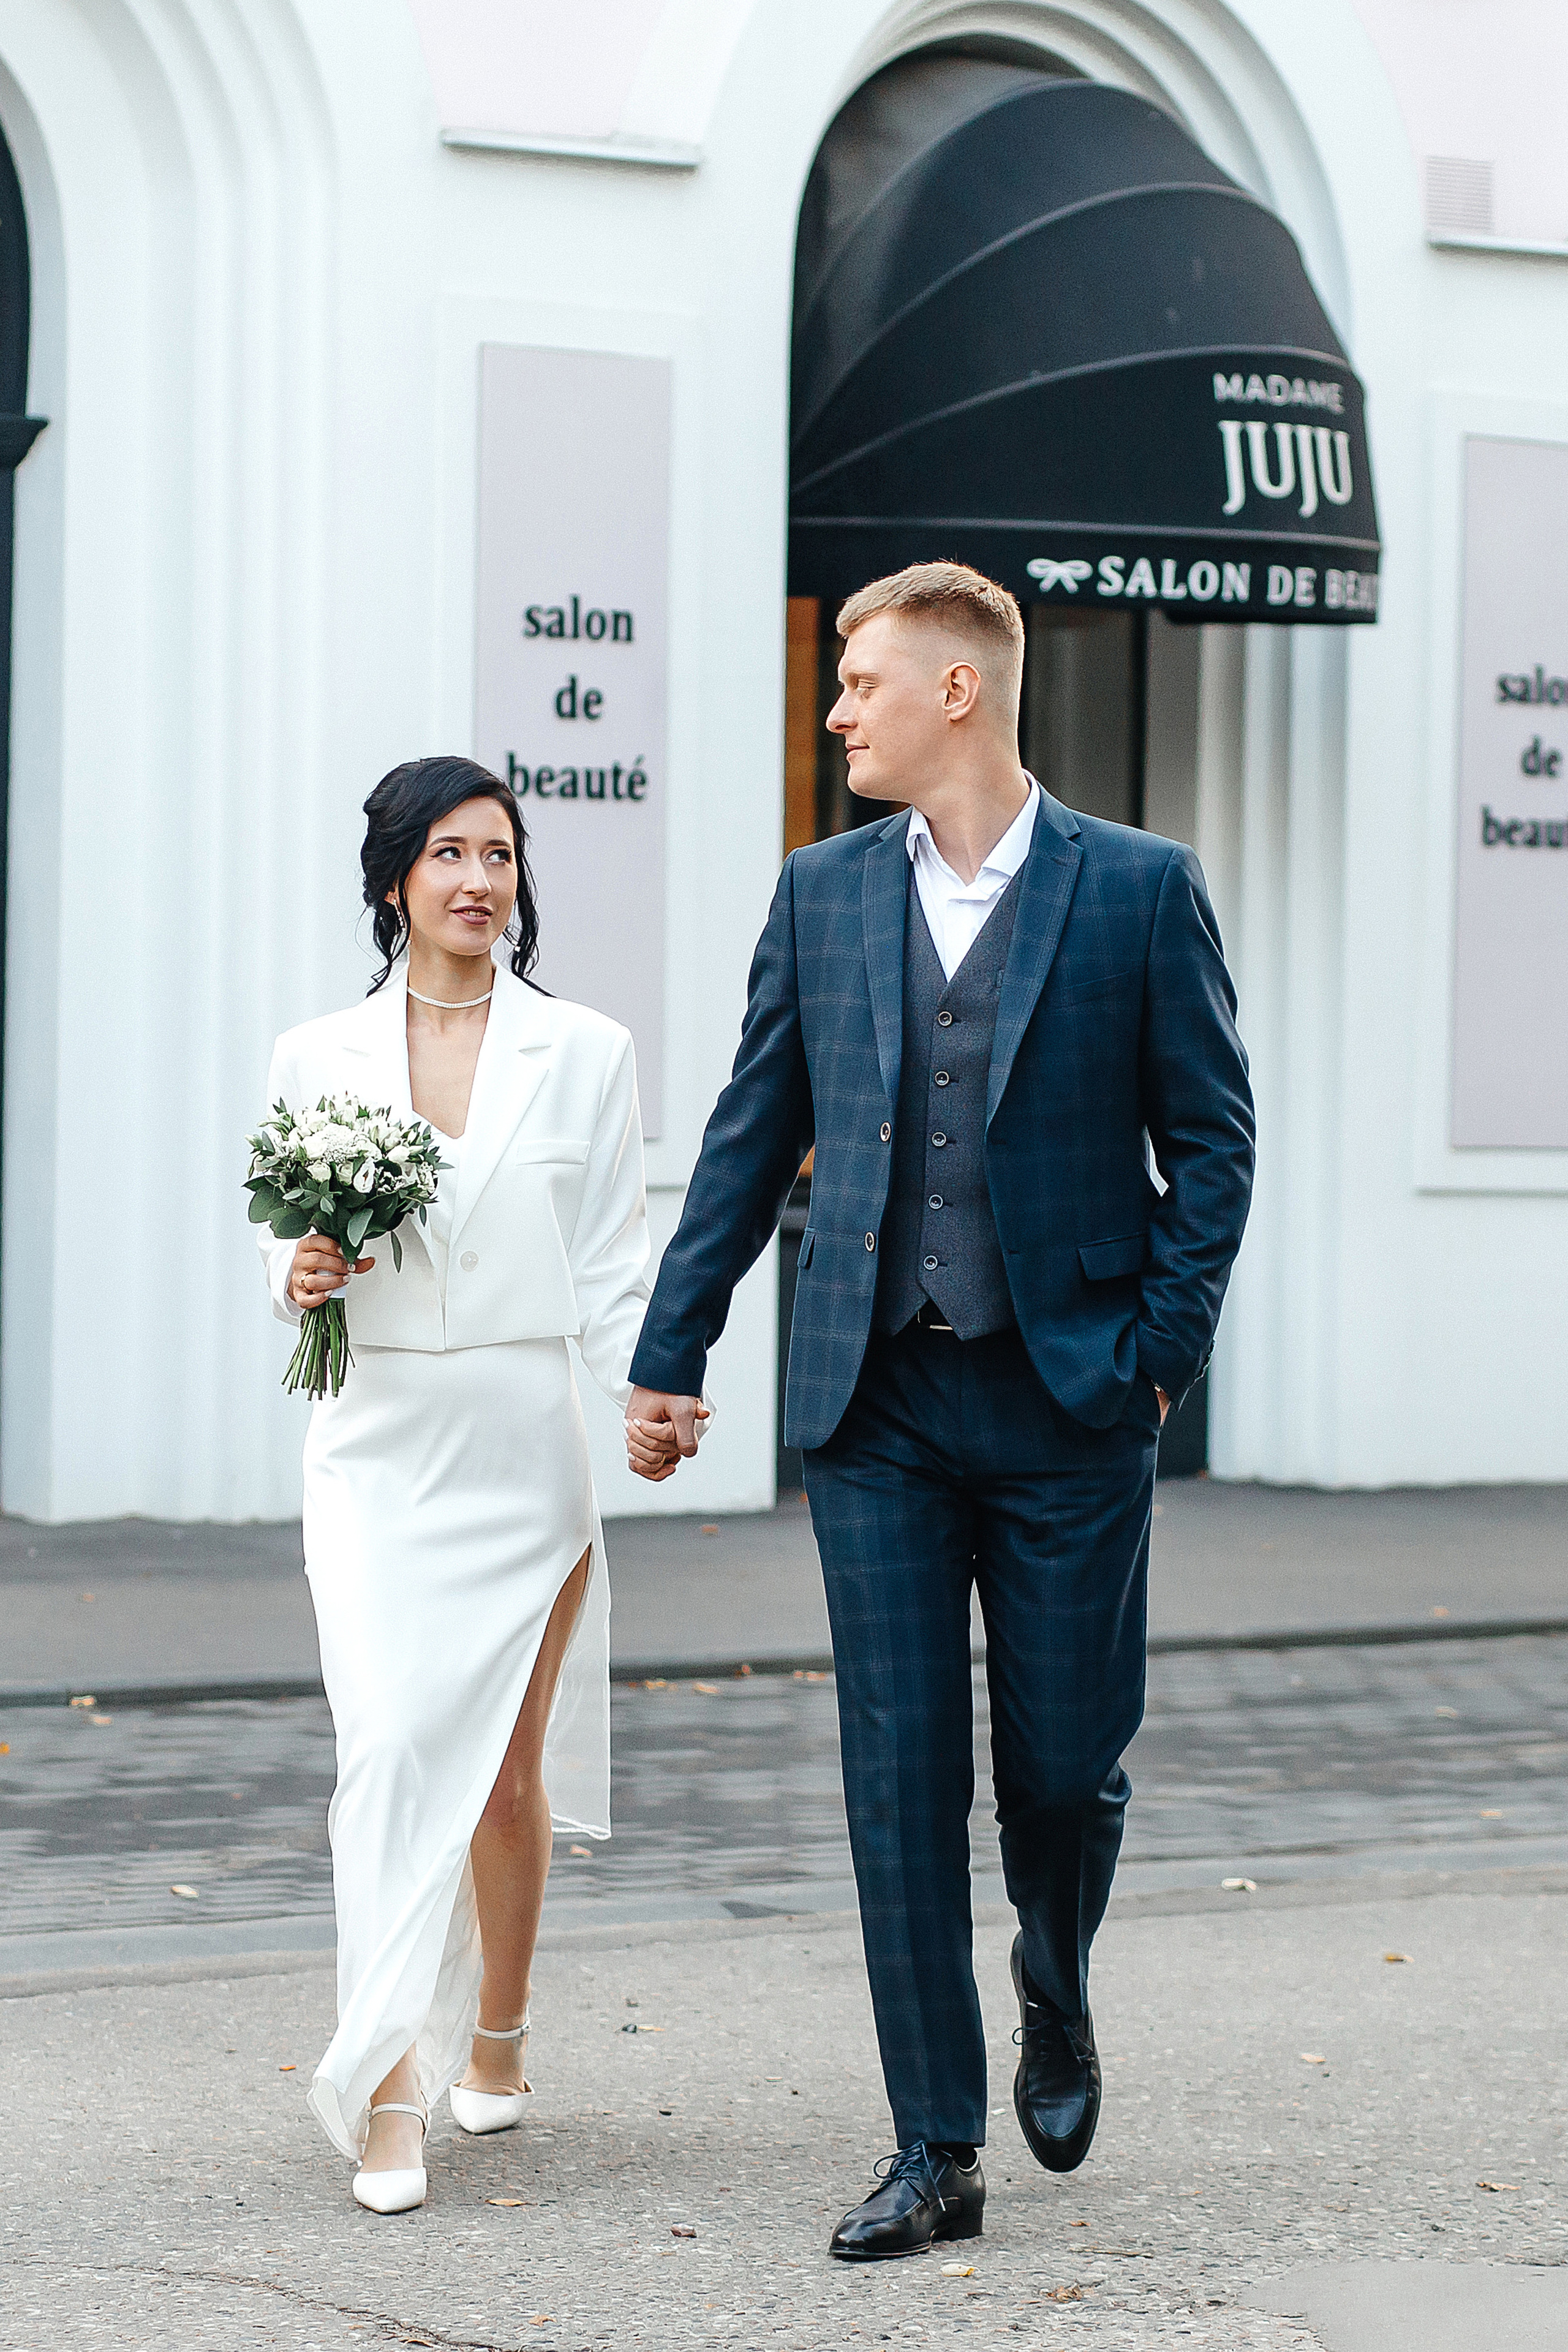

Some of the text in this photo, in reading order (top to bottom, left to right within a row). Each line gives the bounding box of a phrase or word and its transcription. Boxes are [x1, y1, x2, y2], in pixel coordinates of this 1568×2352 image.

[1213, 372, 1344, 414] MADAME
[1218, 420, 1353, 516] JUJU
[1097, 556, 1250, 601] SALON
[1267, 565, 1317, 606] DE
[523, 594, 635, 643] salon
[555, 674, 603, 720] de
[1496, 664, 1568, 705] salo
[507, 751, 647, 801] beauté
[1521, 735, 1562, 778] de
[1480, 804, 1568, 848] beau
